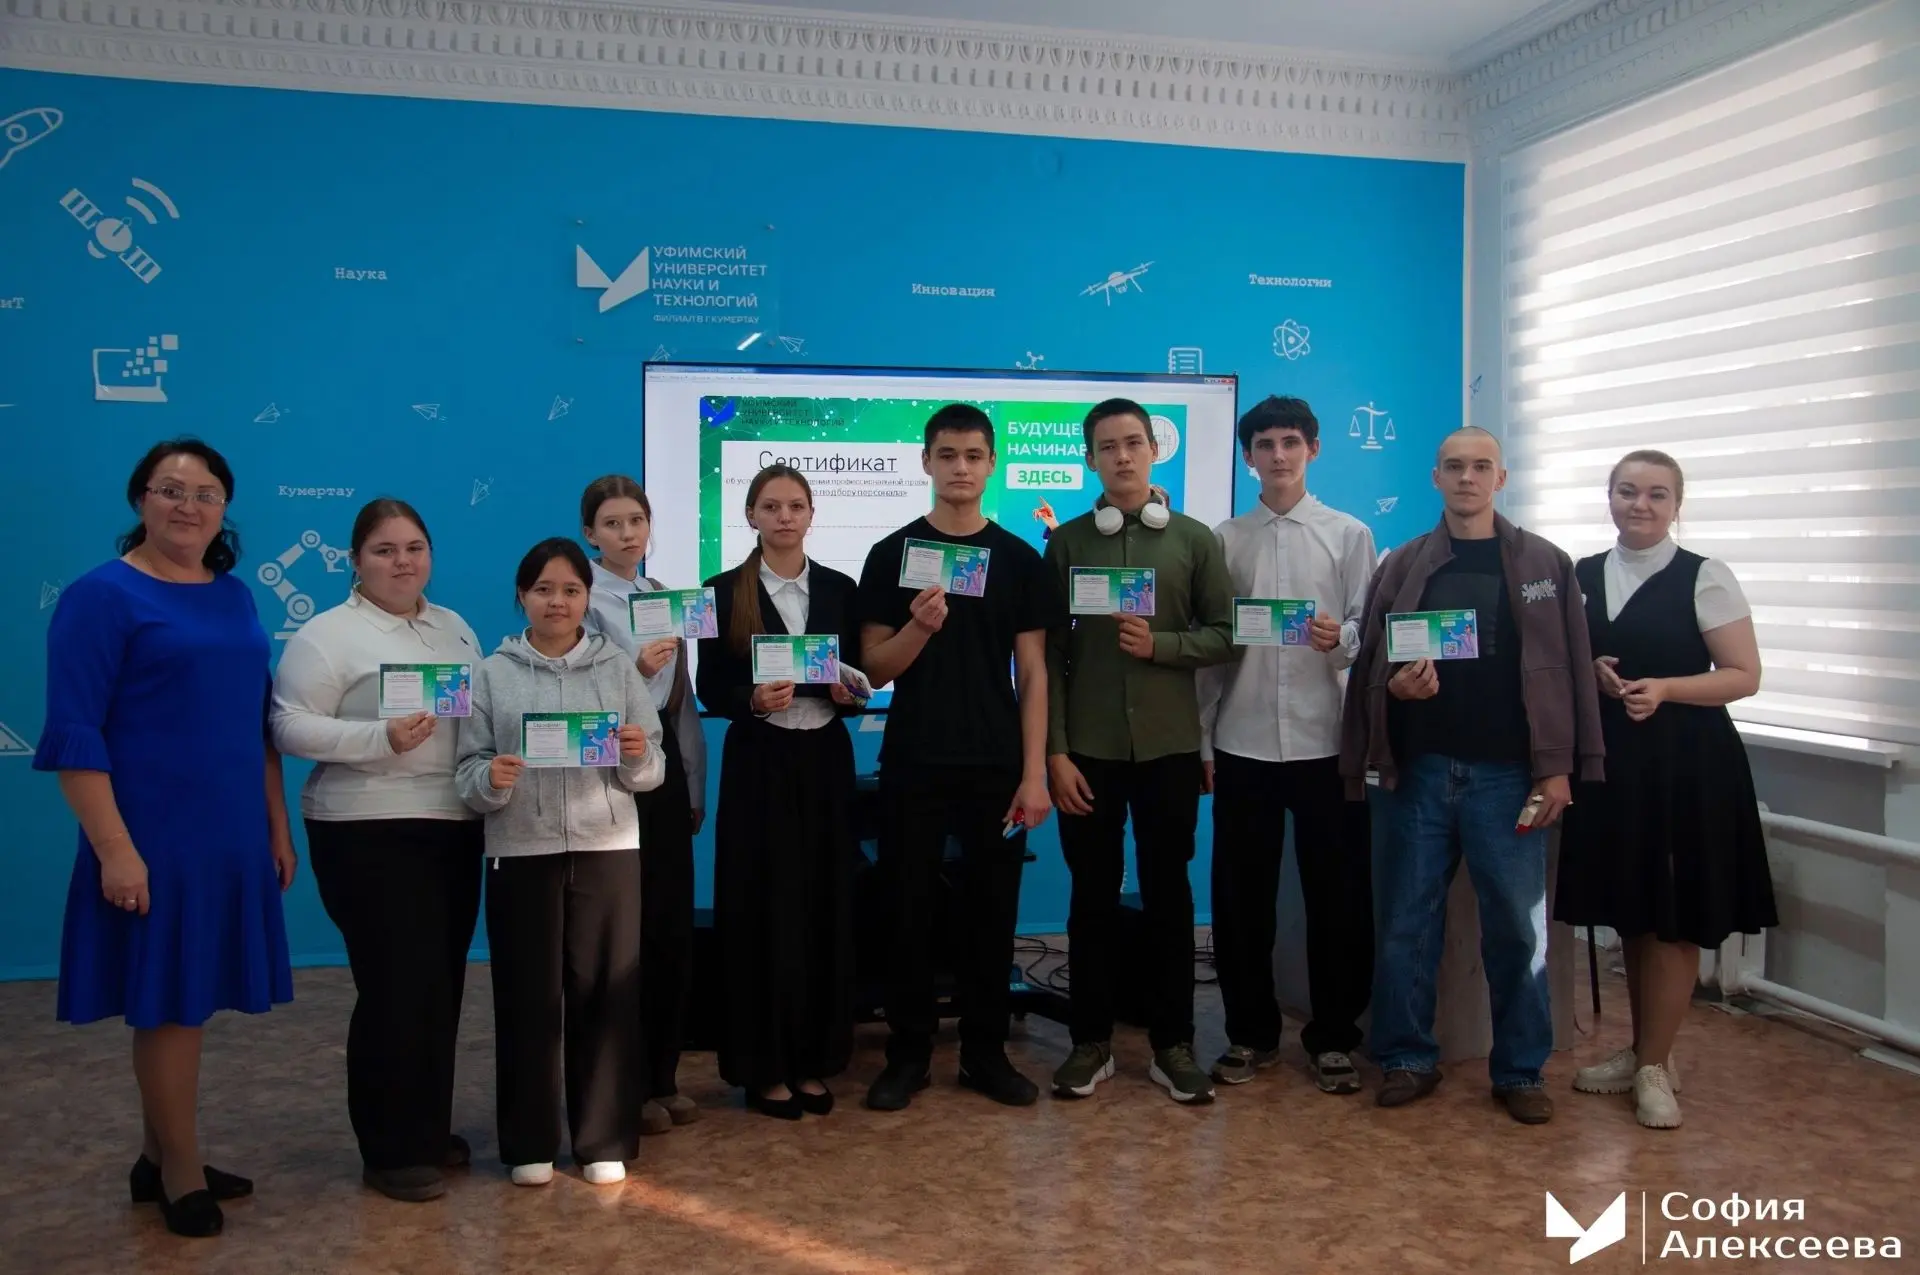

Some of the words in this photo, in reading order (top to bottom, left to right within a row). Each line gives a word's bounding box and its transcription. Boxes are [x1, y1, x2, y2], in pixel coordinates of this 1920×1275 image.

[653, 245, 747, 260] УФИМСКИЙ
[334, 267, 387, 281] Наука
[653, 263, 768, 276] УНИВЕРСИТЕТ
[651, 278, 704, 291] НАУКИ
[708, 280, 719, 291] И
[1248, 273, 1332, 288] Технологии
[911, 283, 996, 298] Инновация
[653, 293, 758, 308] ТЕХНОЛОГИЙ
[1007, 421, 1084, 438] БУДУЩЕ
[1007, 443, 1087, 457] НАЧИНАЕ
[759, 450, 898, 474] Сертификат
[1017, 470, 1073, 486] ЗДЕСЬ
[278, 485, 356, 499] Кумертау
